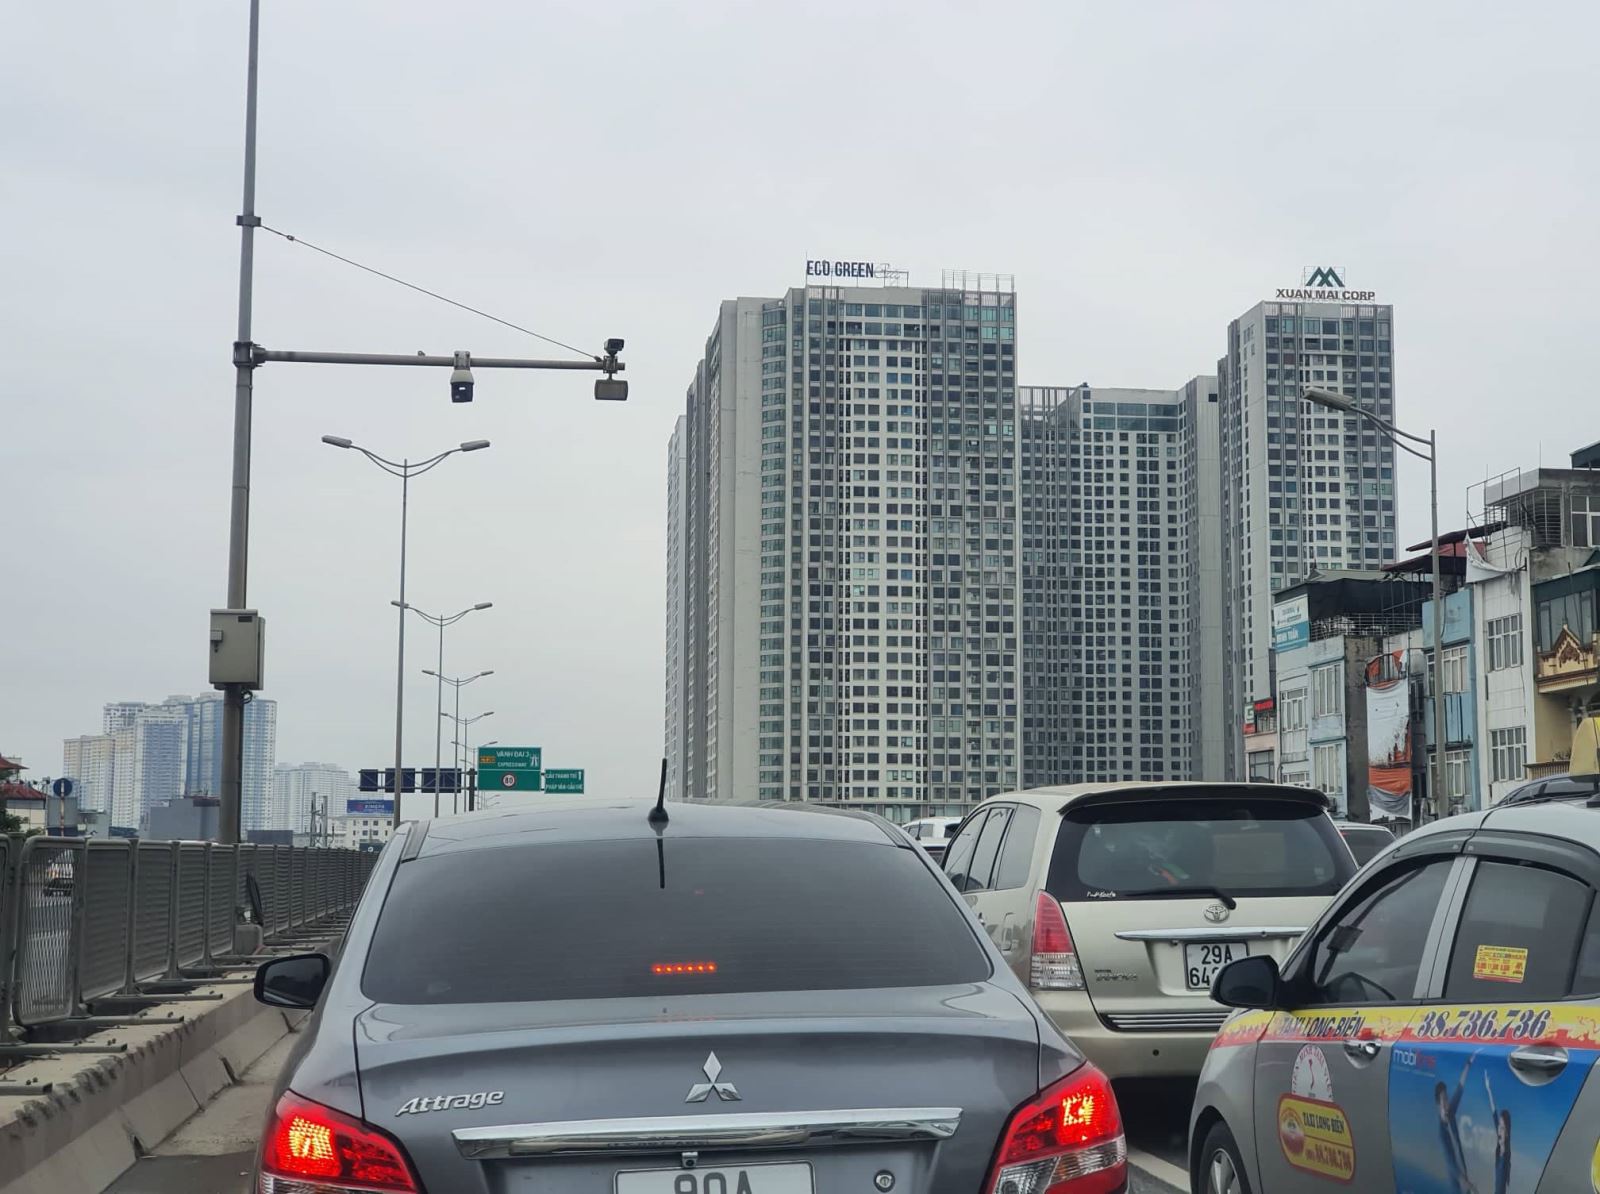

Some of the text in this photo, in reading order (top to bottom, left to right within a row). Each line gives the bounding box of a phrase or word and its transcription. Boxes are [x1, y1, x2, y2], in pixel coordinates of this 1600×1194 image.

[806, 259, 874, 278] ECO GREEN
[1276, 288, 1375, 301] XUAN MAI CORP
[1200, 944, 1233, 965] 29A
[1189, 966, 1219, 987] 64
[1305, 1016, 1336, 1038] LONG
[1416, 1008, 1552, 1040] 38.736.736
[394, 1090, 505, 1118] Attrage
